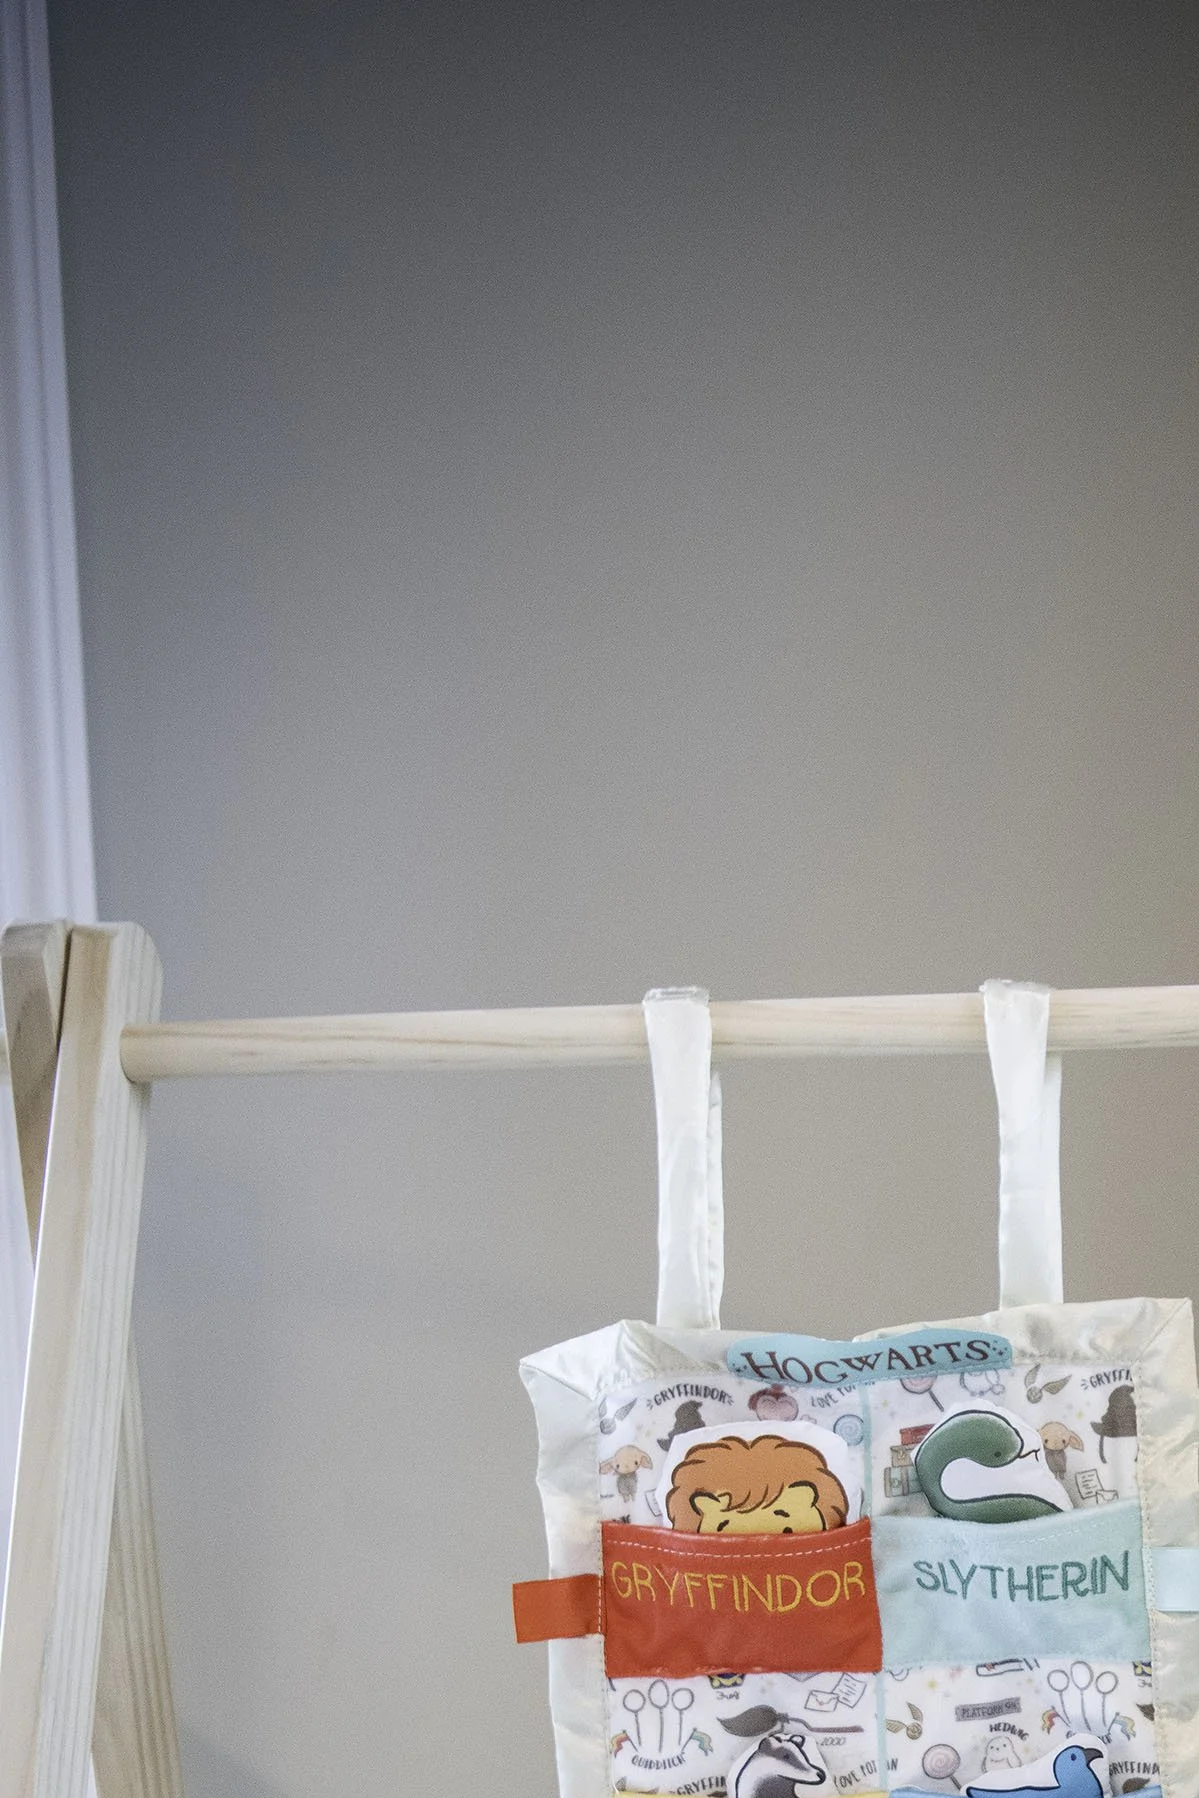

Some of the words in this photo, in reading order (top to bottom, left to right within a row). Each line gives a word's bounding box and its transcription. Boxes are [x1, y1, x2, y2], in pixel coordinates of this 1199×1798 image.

[740, 1339, 991, 1385] HOGWARTS
[653, 1383, 728, 1406] GRYFFINDOR
[611, 1561, 866, 1612] GRYFFINDOR
[913, 1550, 1129, 1602] SLYTHERIN
